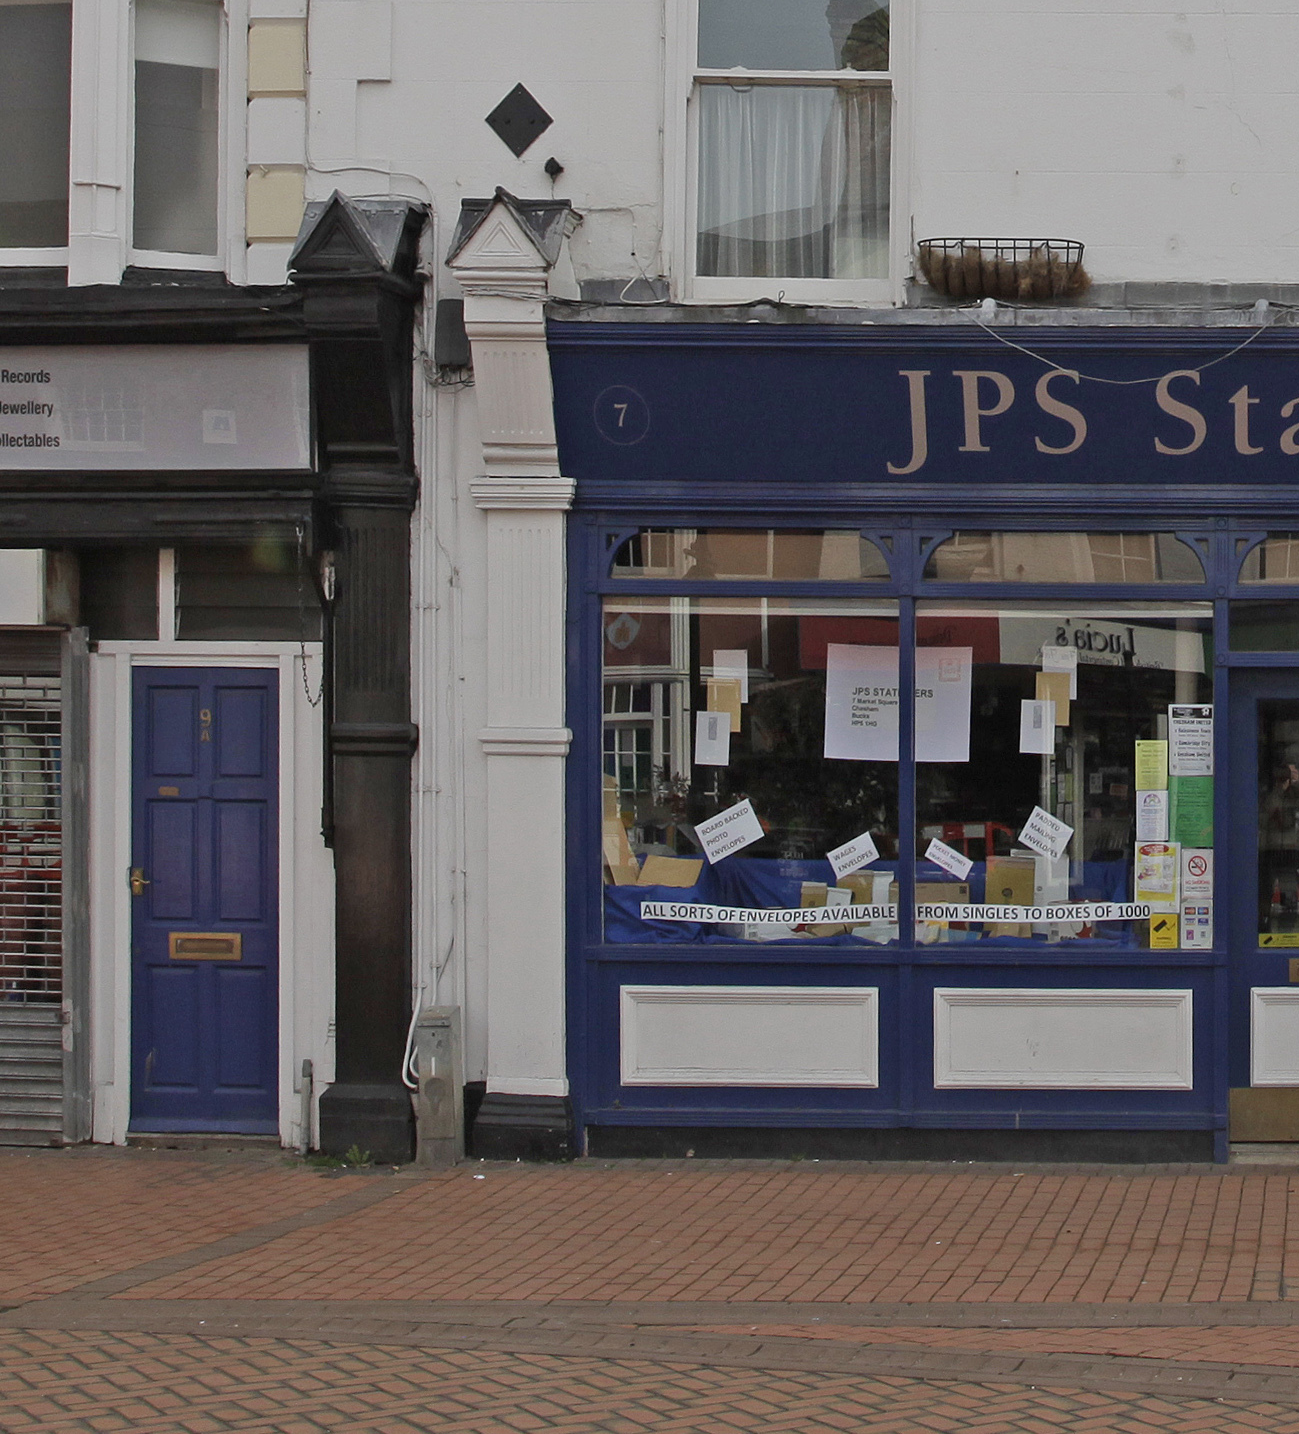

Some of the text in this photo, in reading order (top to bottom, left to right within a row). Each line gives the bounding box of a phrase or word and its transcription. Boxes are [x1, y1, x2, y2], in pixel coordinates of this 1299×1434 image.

[1, 369, 51, 383] Records
[613, 403, 628, 427] 7
[887, 369, 1088, 474] JPS
[852, 687, 870, 696] JPS
[701, 807, 749, 836] BOARD BACKED
[1034, 812, 1060, 831] PADDED
[706, 831, 728, 847] PHOTO
[711, 835, 746, 857] ENVELOPES
[643, 904, 1150, 922] ALL SORTS OF ENVELOPES AVAILABLE FROM SINGLES TO BOXES OF 1000
